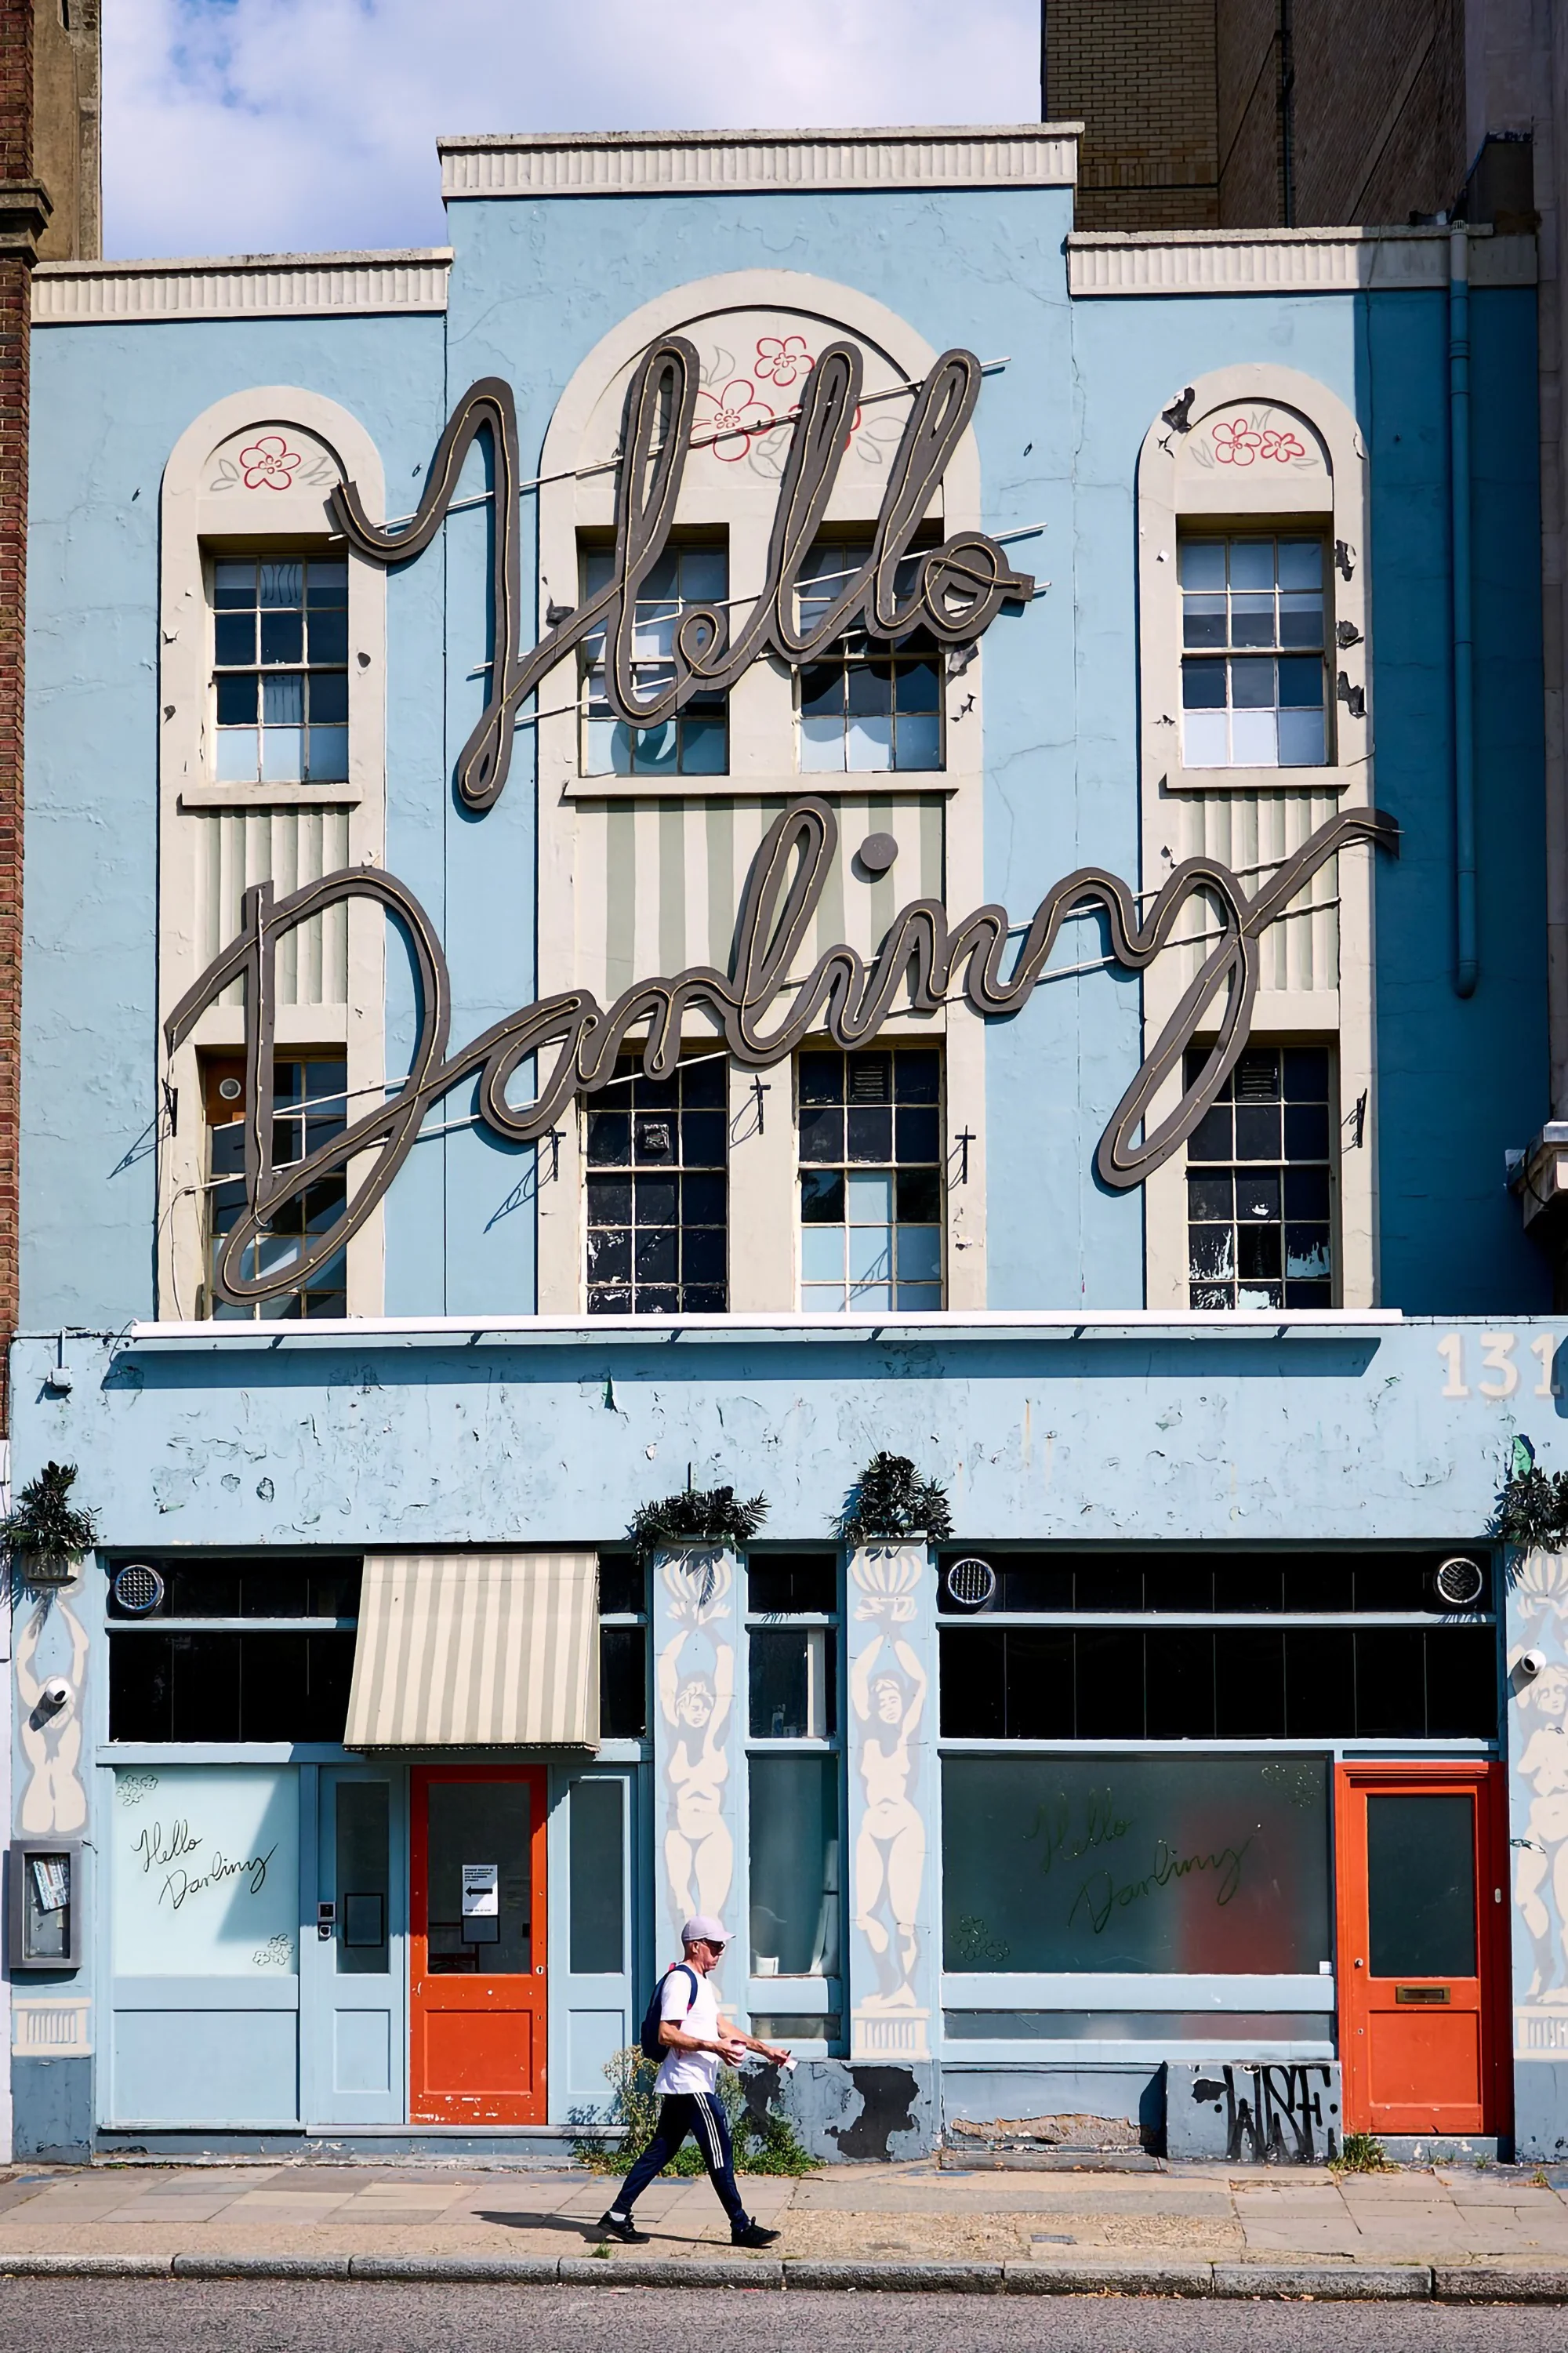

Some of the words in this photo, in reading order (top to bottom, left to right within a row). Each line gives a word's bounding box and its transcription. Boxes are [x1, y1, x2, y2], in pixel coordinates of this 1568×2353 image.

[329, 335, 1036, 810] Hello
[164, 794, 1400, 1306] Darling
[1437, 1332, 1563, 1398] 131
[130, 1818, 203, 1872] Hello
[1022, 1786, 1135, 1875] Hello
[158, 1842, 279, 1910] Darling
[1067, 1823, 1262, 1934] Darling
